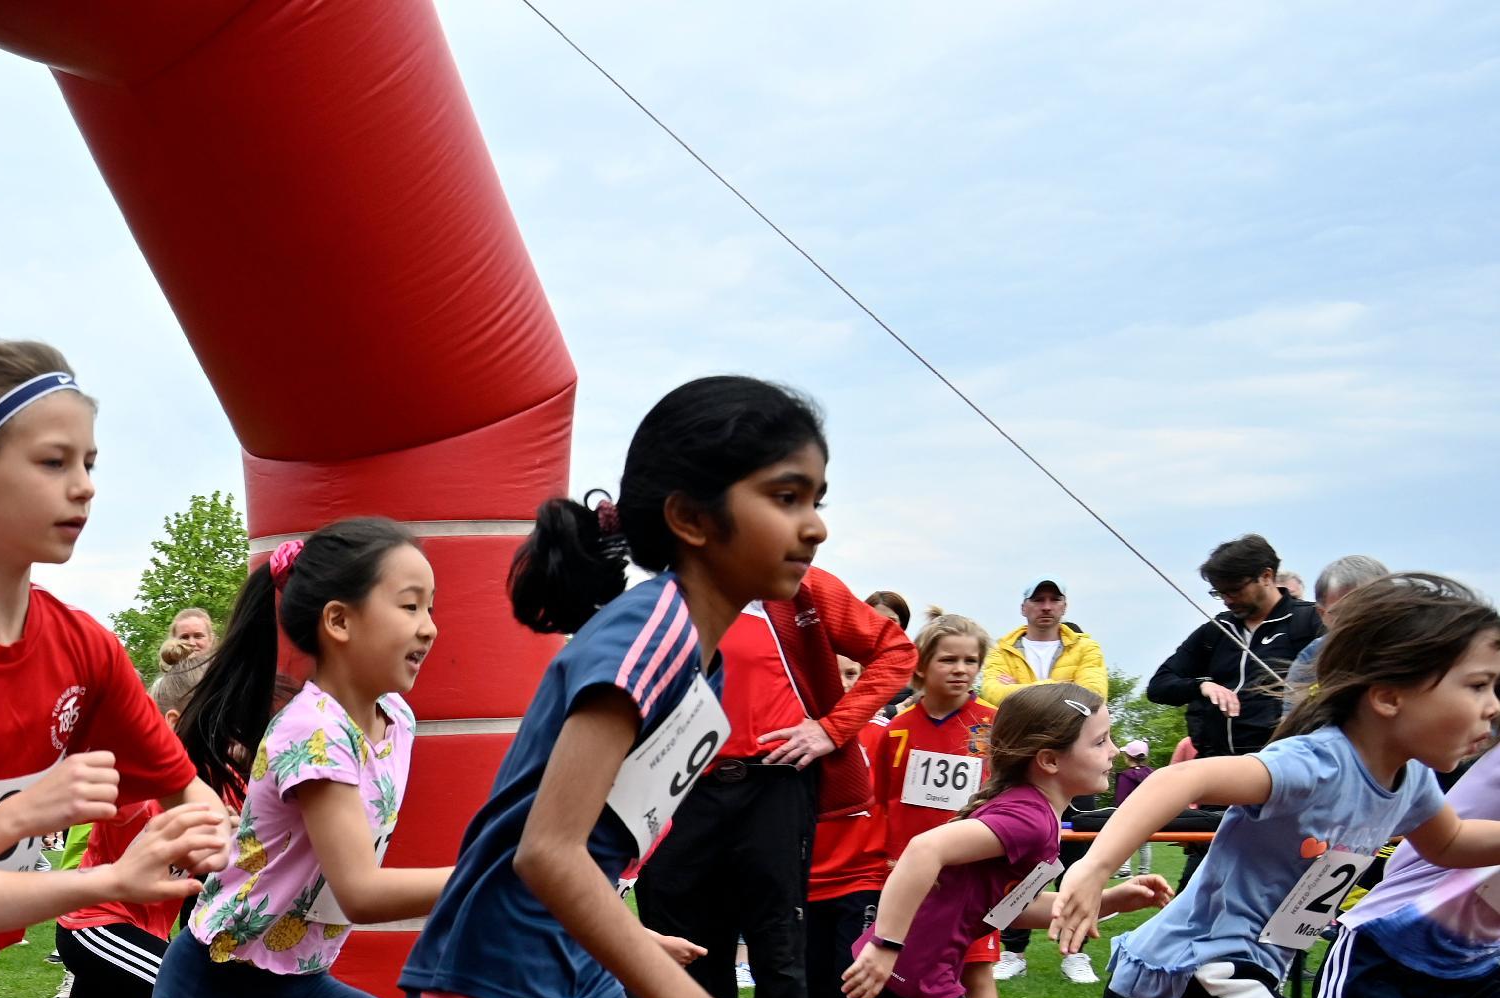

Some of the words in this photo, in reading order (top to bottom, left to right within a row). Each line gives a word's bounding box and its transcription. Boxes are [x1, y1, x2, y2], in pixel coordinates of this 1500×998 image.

[669, 730, 719, 797] 9
[889, 729, 908, 767] 7
[921, 757, 969, 790] 136
[925, 793, 949, 803] David
